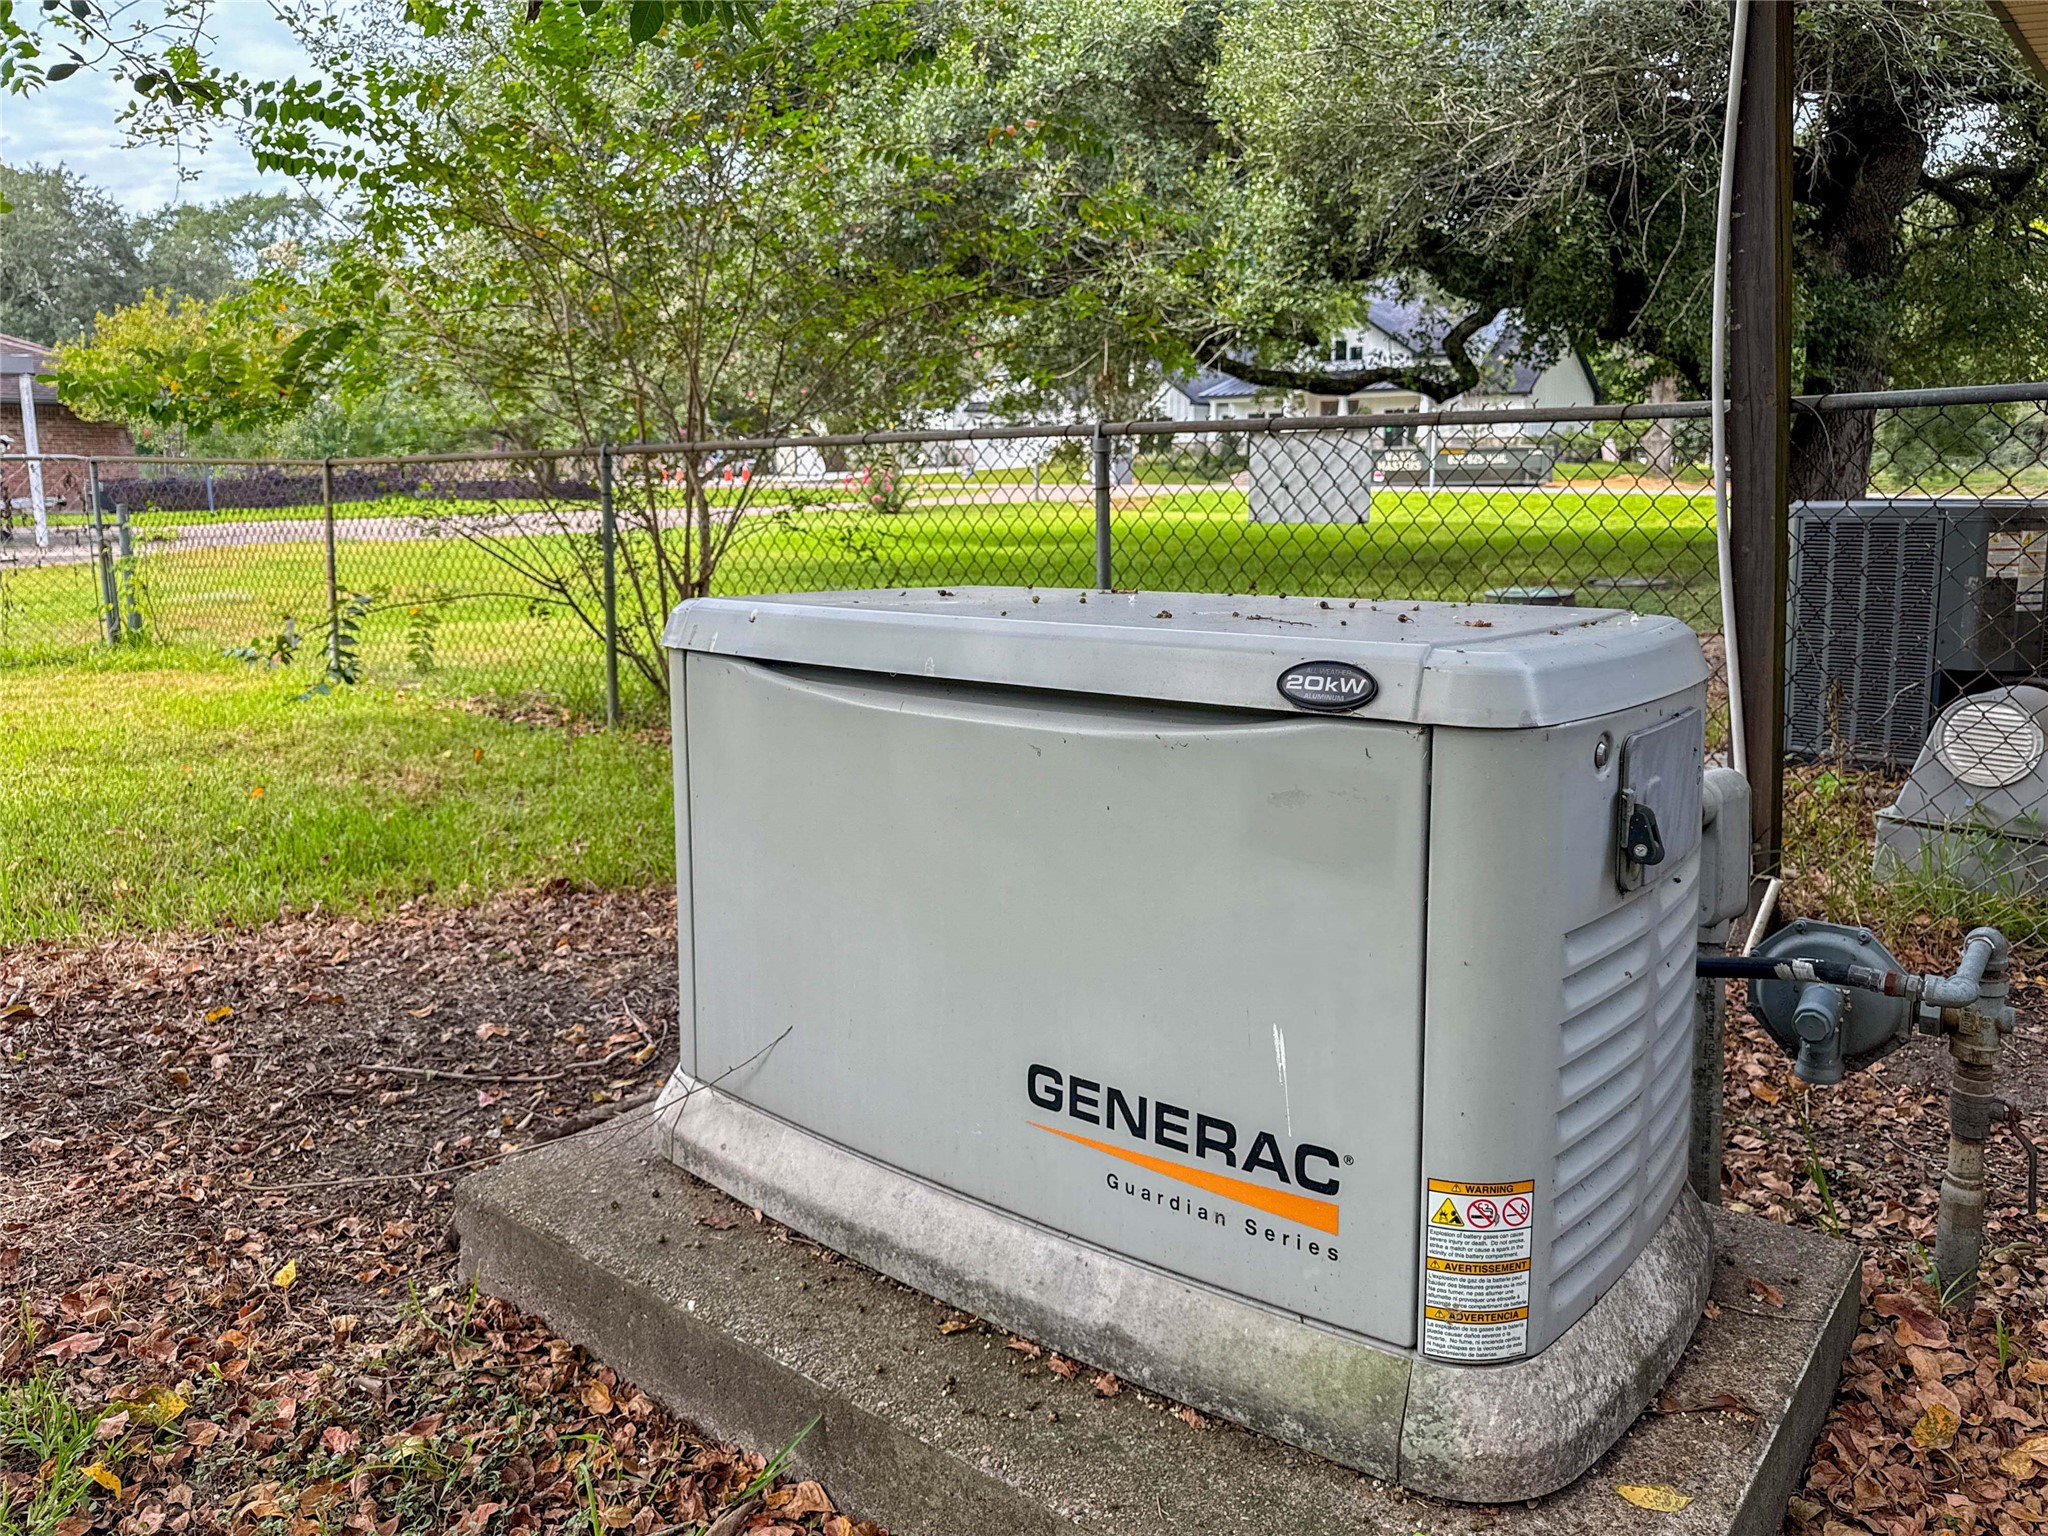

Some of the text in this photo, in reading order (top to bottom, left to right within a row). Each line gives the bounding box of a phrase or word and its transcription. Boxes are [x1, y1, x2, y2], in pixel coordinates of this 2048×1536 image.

[1320, 668, 1352, 676] WEATHER
[1286, 675, 1367, 694] 20kW
[1304, 692, 1344, 702] ALUMINUM
[1465, 1185, 1514, 1194] WARNING
[1106, 1173, 1339, 1261] Guardian Series
[1444, 1261, 1527, 1272] AVERTISSEMENT
[1449, 1311, 1518, 1322] ADVERTENCIA
